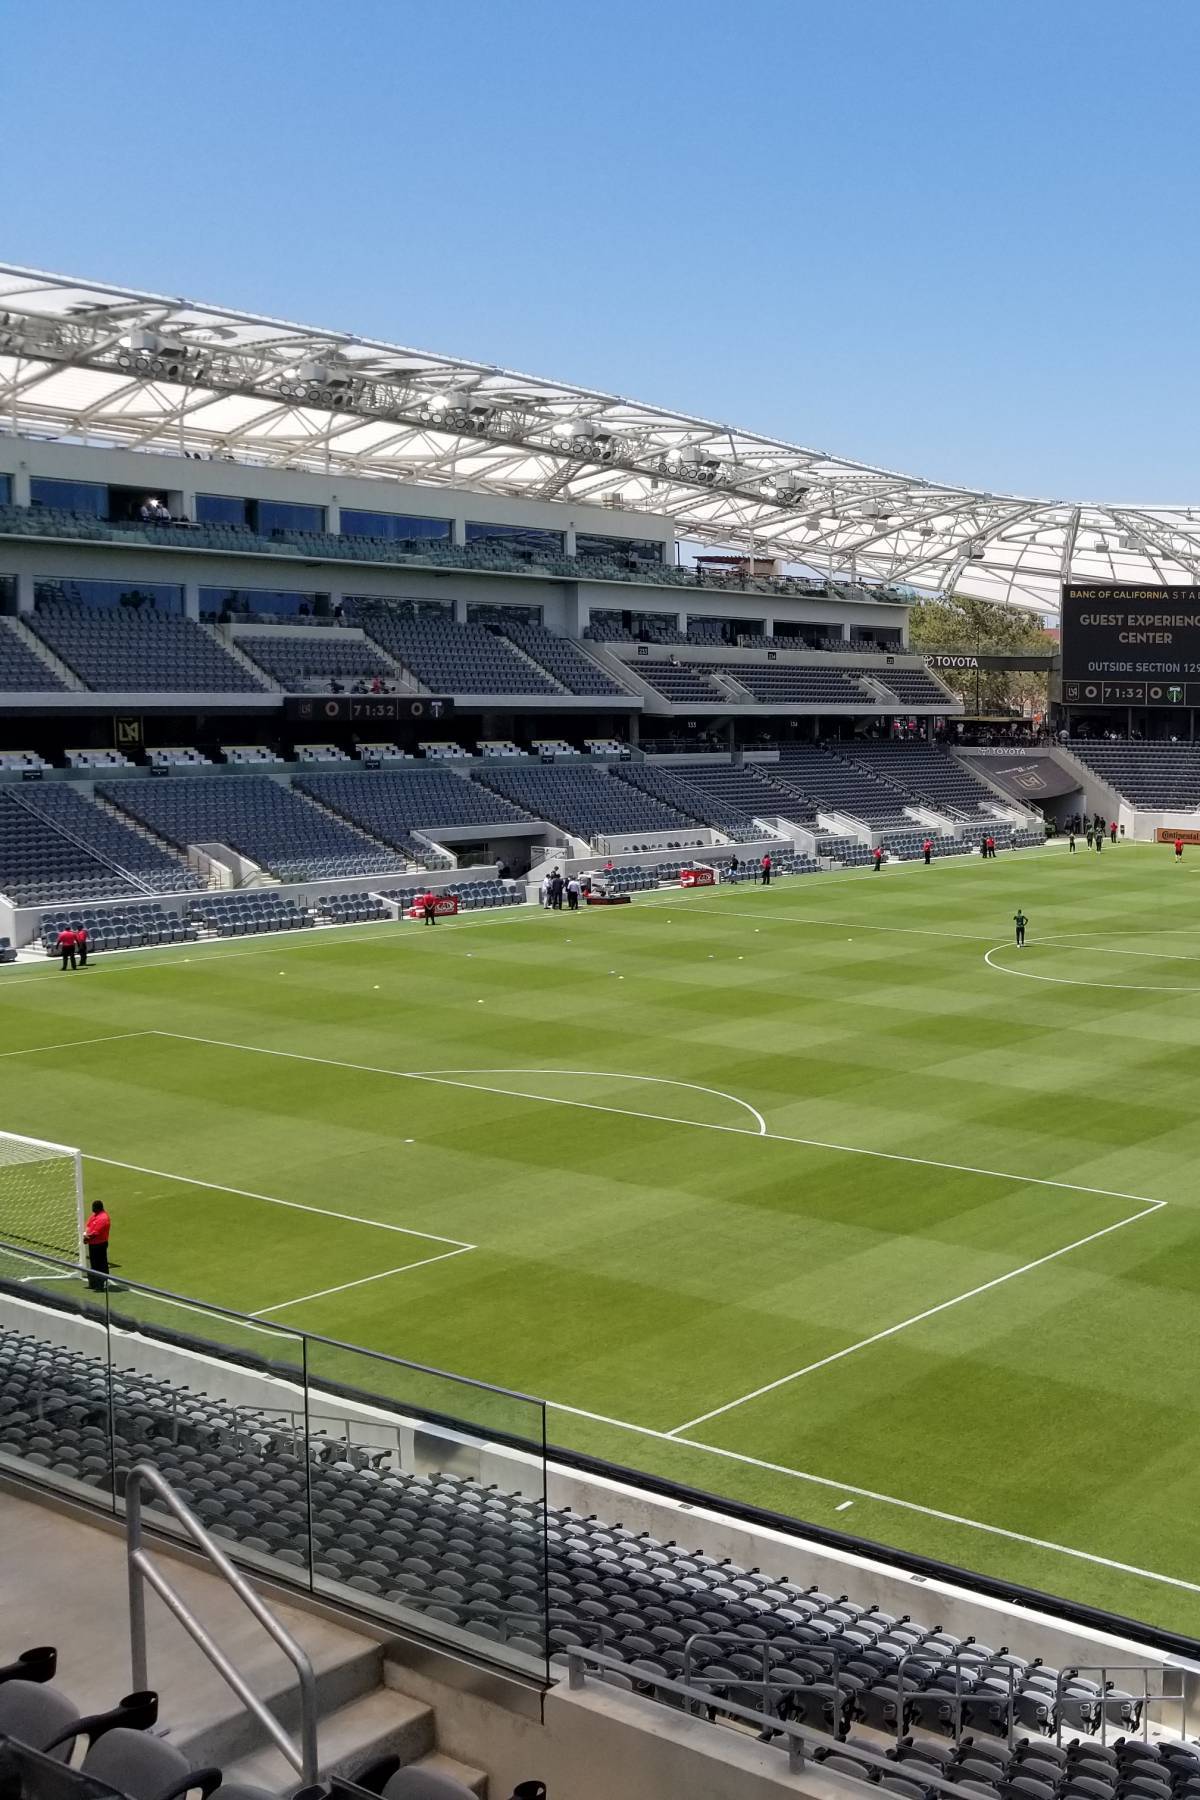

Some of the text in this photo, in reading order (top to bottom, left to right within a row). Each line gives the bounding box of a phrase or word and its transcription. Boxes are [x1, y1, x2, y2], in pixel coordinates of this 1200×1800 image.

[1070, 591, 1096, 599] BANC
[1098, 591, 1111, 599] OF
[1113, 591, 1169, 599] CALIFORNIA
[1080, 614, 1124, 626] GUEST
[1118, 632, 1173, 644] CENTER
[936, 656, 978, 667] TOYOTA
[1088, 662, 1133, 672] OUTSIDE
[1136, 662, 1180, 673] SECTION
[1104, 688, 1144, 698] 71:32
[353, 705, 394, 717] 71:32
